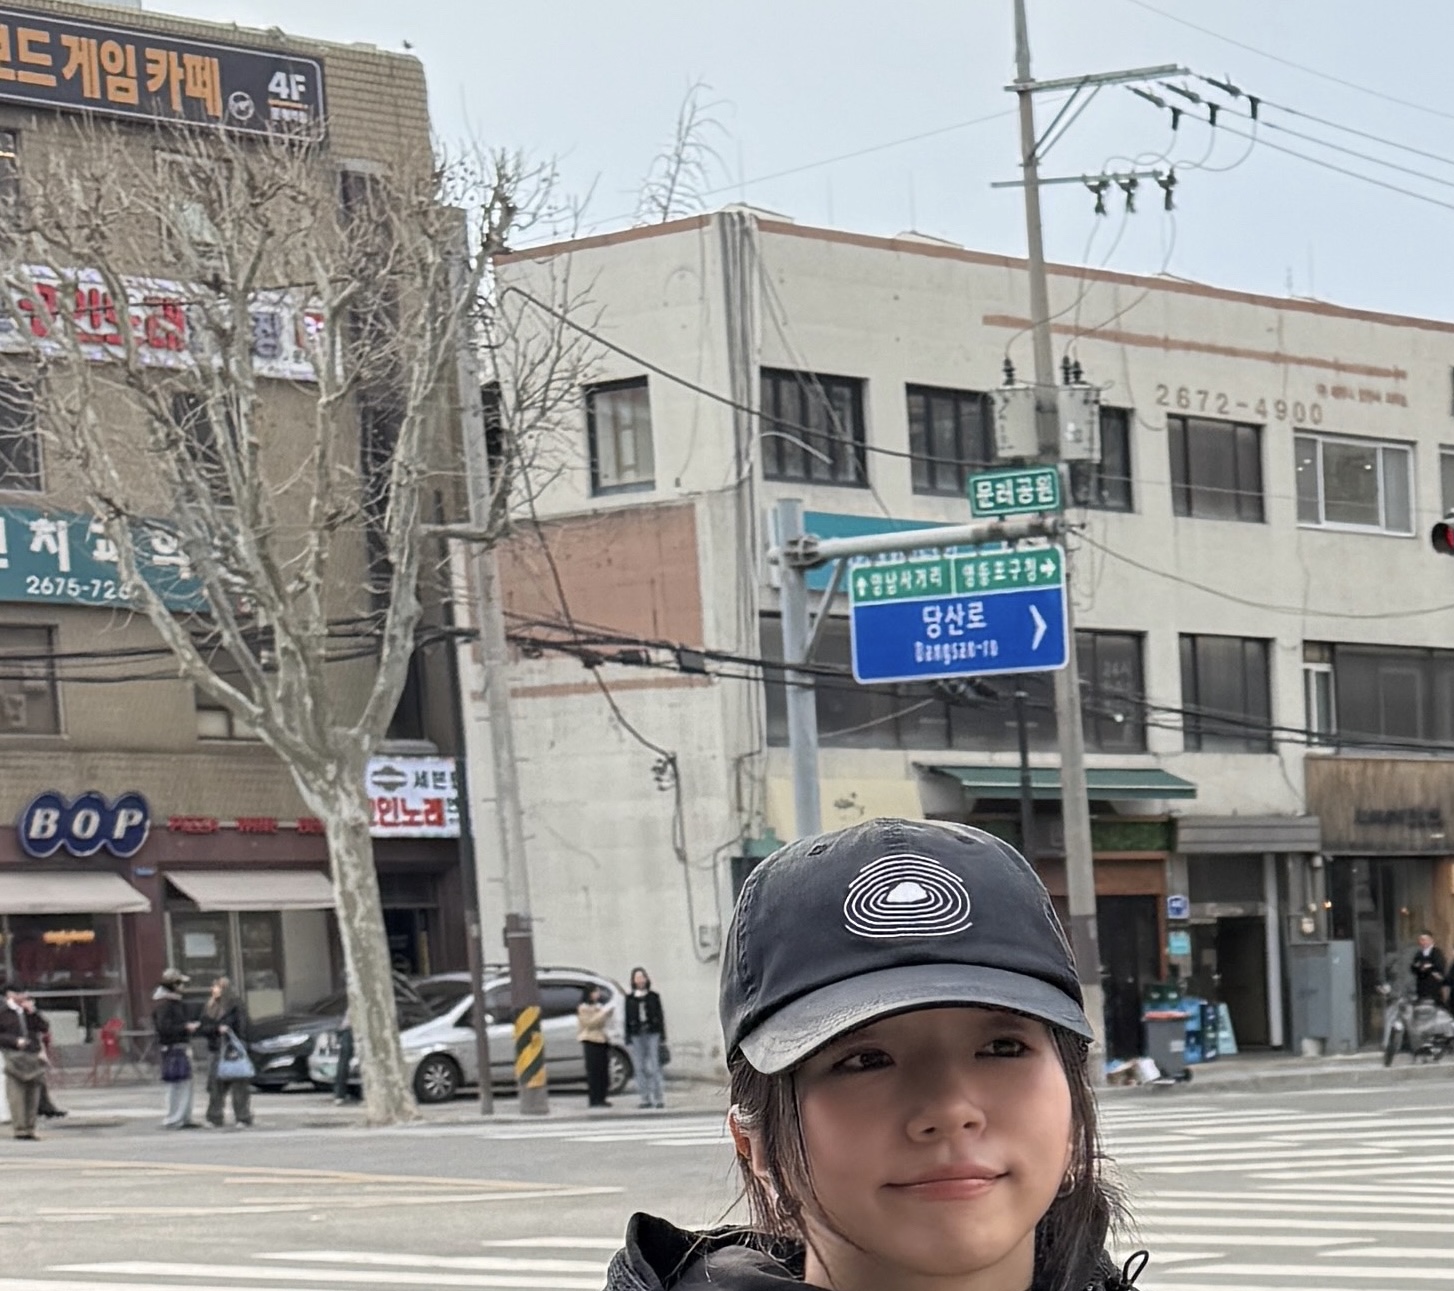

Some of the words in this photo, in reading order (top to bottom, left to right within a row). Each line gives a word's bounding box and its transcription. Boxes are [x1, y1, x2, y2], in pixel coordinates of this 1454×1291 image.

[145, 47, 223, 120] 카페
[267, 70, 306, 101] 4F
[1155, 382, 1323, 426] 2672-4900
[922, 600, 988, 639] 당산로
[28, 806, 145, 841] BOP
